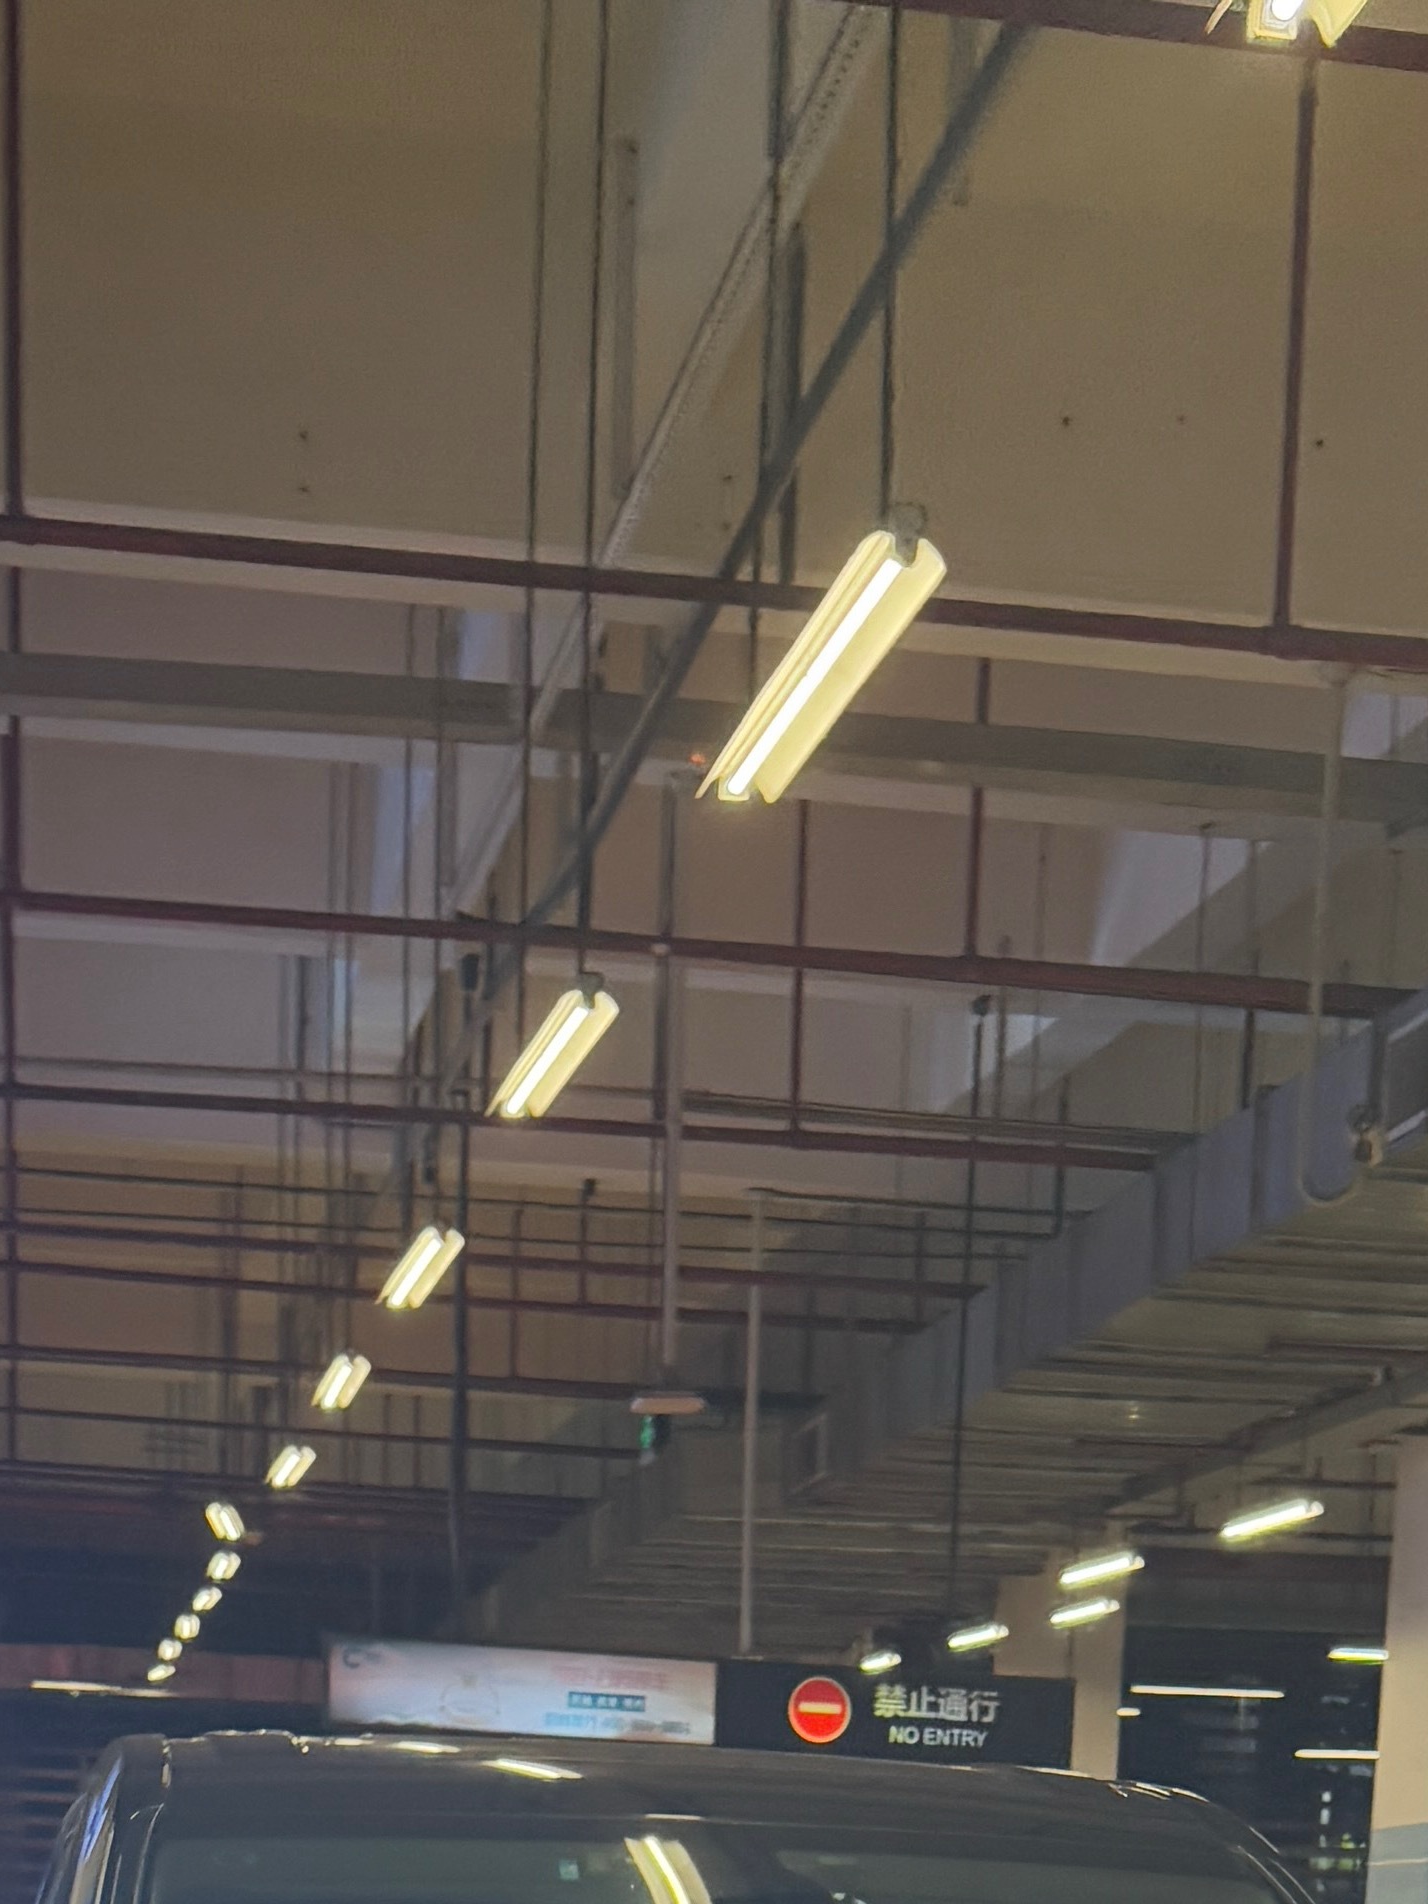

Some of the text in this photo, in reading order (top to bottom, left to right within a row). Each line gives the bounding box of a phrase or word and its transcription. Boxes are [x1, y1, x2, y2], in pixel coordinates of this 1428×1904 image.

[874, 1684, 999, 1722] 禁止通行
[889, 1726, 987, 1747] NO ENTRY
